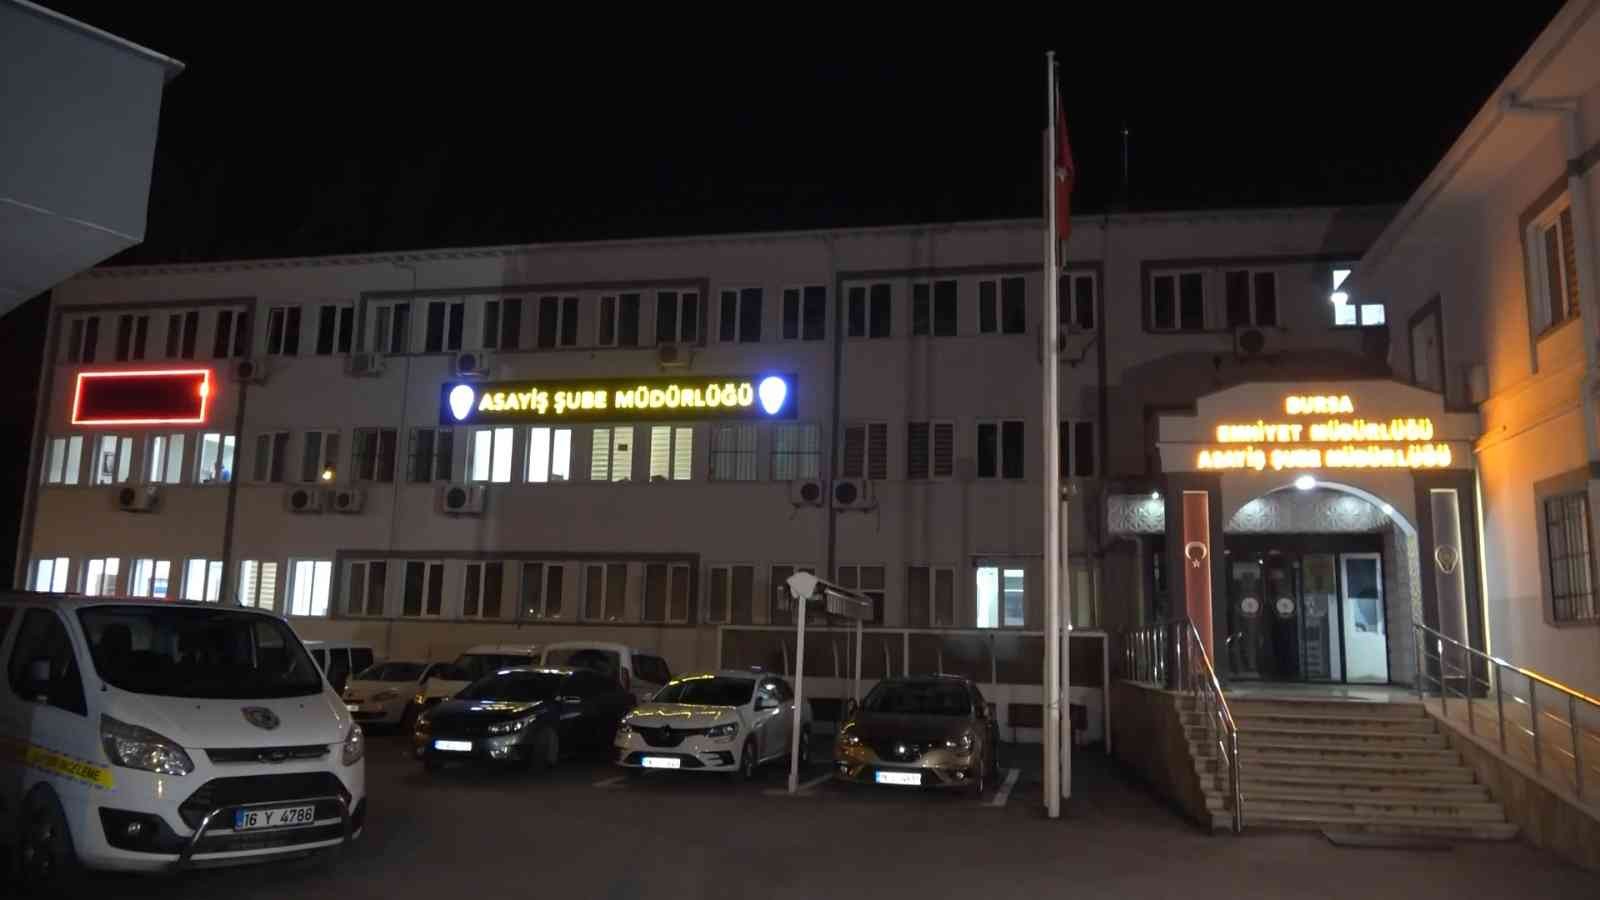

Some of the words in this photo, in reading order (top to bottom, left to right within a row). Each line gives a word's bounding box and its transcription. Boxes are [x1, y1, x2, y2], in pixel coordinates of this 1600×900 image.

[478, 388, 549, 414] ASAYİŞ
[554, 389, 608, 414] ŞUBE
[615, 382, 753, 409] MÜDÜRLÜĞÜ
[243, 812, 258, 828] 16
[264, 811, 274, 825] Y
